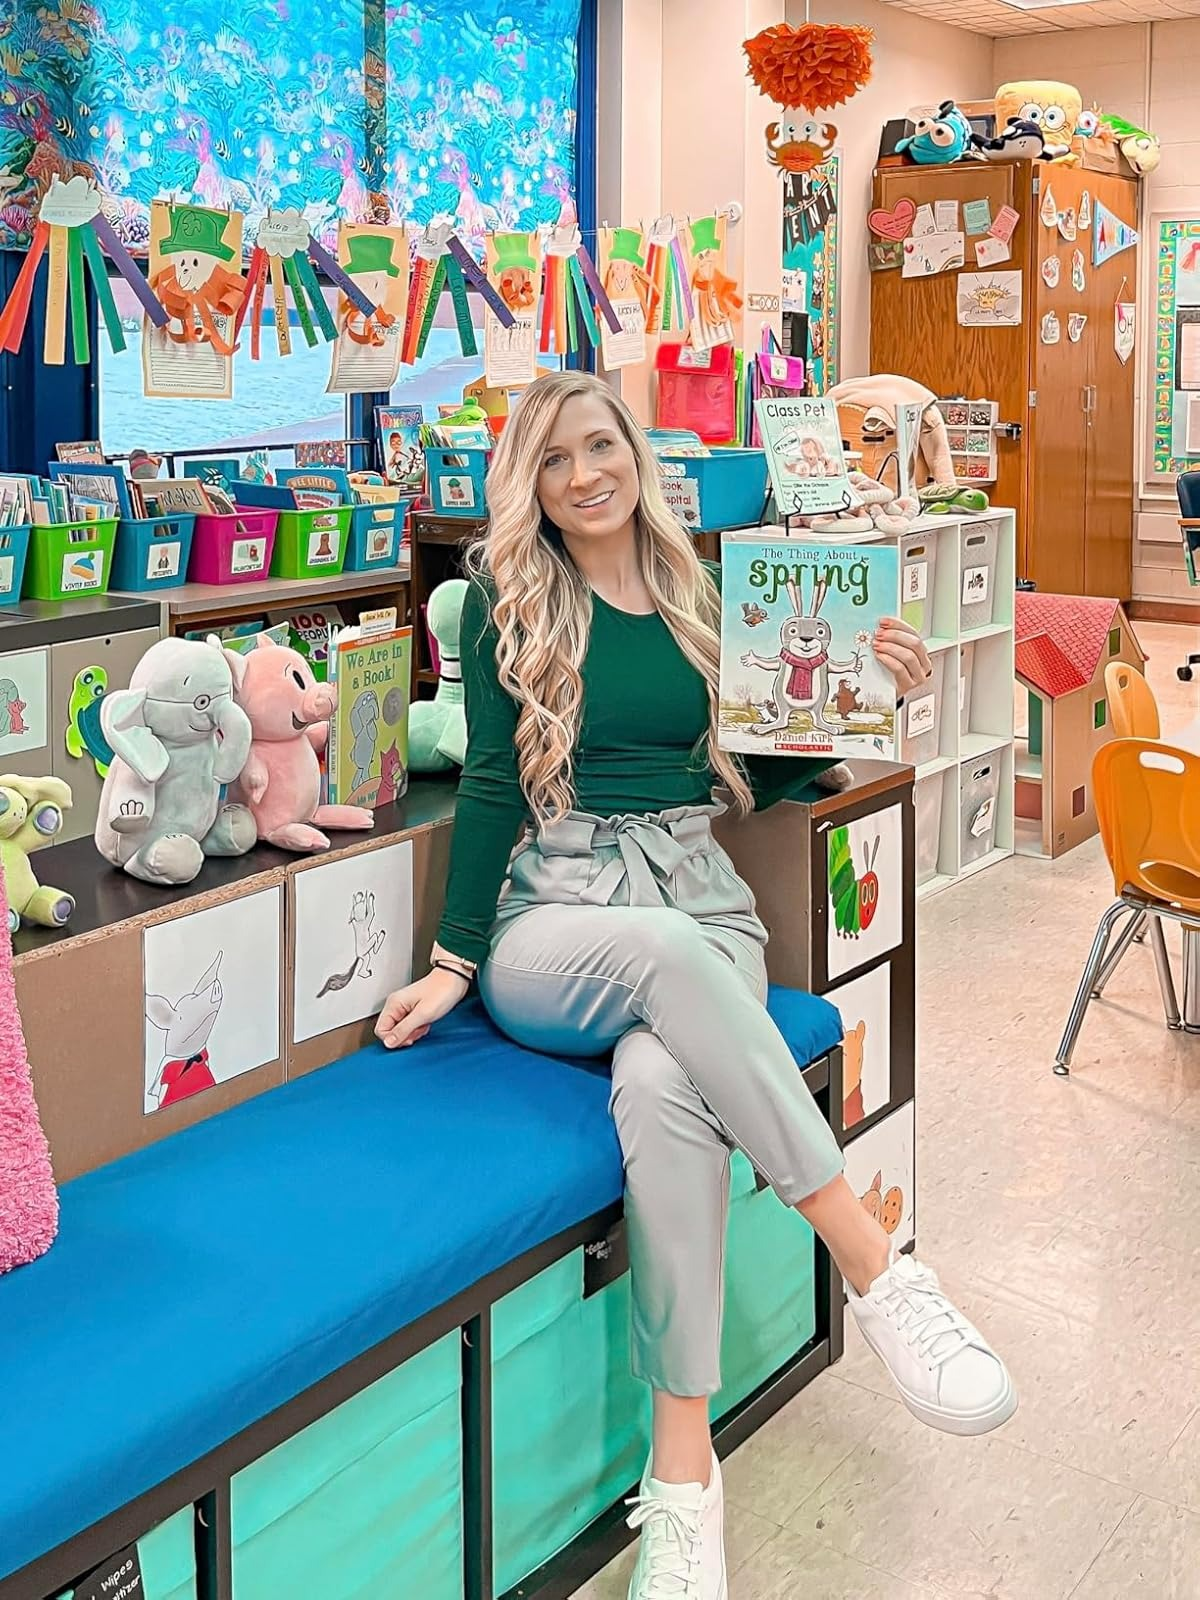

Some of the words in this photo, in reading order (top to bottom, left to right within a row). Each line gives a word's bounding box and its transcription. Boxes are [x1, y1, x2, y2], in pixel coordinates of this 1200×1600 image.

[766, 404, 801, 418] Class
[804, 402, 826, 417] Pet
[664, 495, 692, 506] spital
[761, 548, 783, 559] The
[787, 548, 820, 561] Thing
[824, 550, 857, 560] About
[291, 613, 327, 630] 100
[346, 652, 364, 670] We
[367, 648, 388, 666] Are
[352, 677, 359, 690] a
[363, 663, 396, 687] Book!
[775, 731, 807, 743] Daniel
[811, 732, 834, 743] Kirk
[101, 1559, 133, 1592] Wipes
